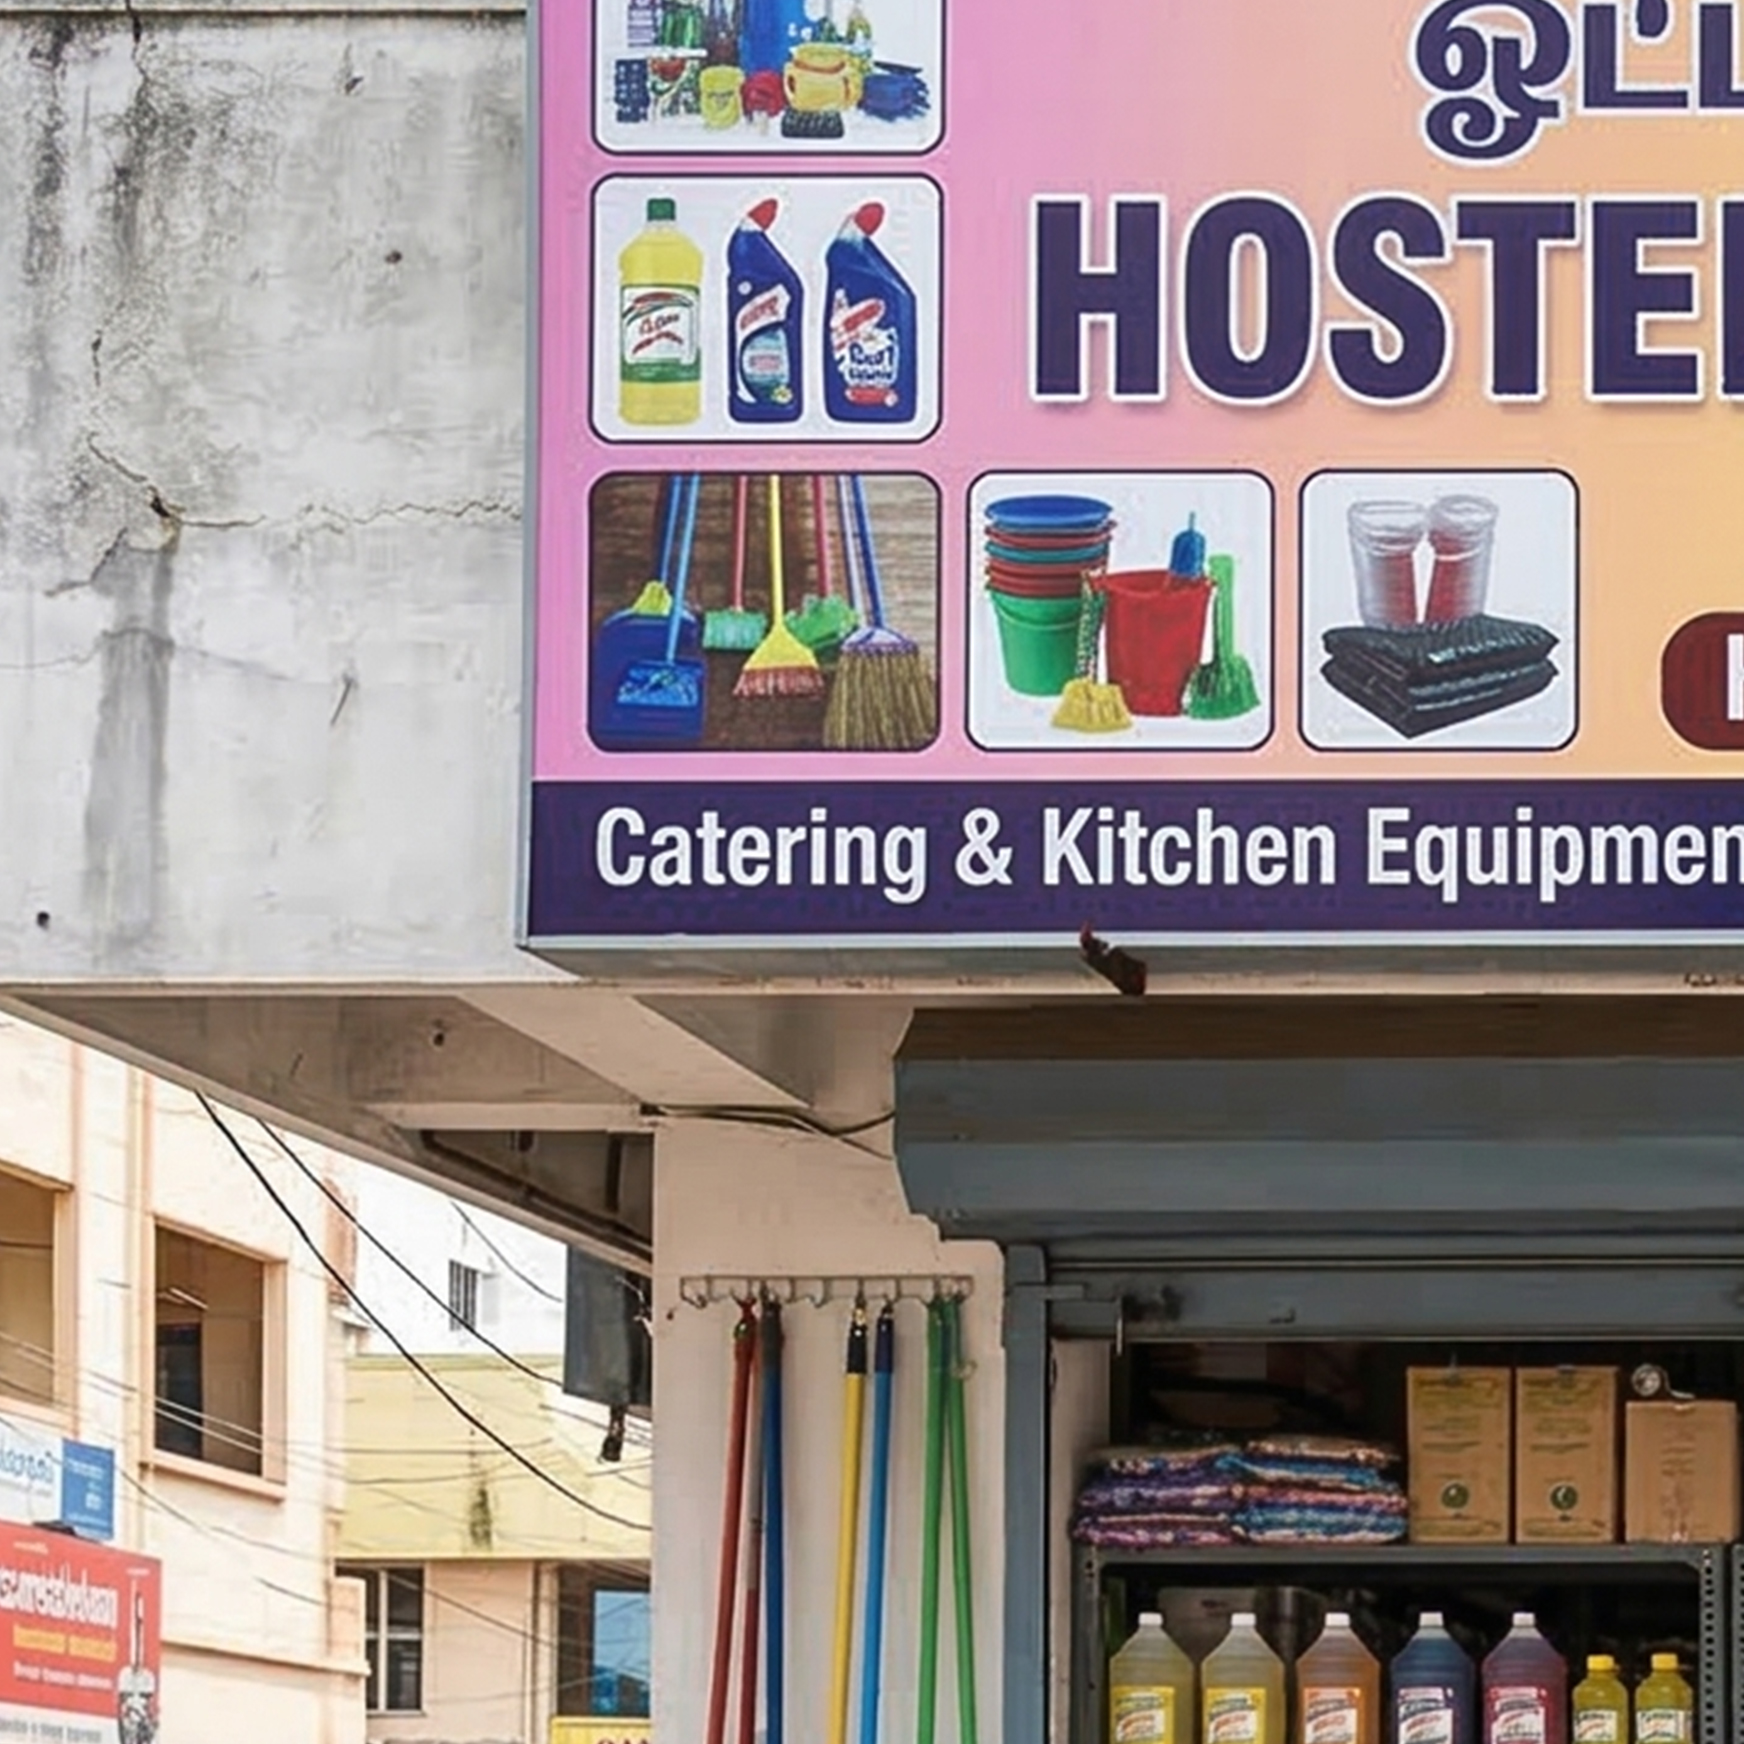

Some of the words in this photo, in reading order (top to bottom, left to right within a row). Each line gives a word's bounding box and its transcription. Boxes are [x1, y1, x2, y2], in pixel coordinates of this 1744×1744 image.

[596, 806, 927, 903] Catering
[954, 807, 1013, 886] &
[1043, 806, 1336, 886] Kitchen
